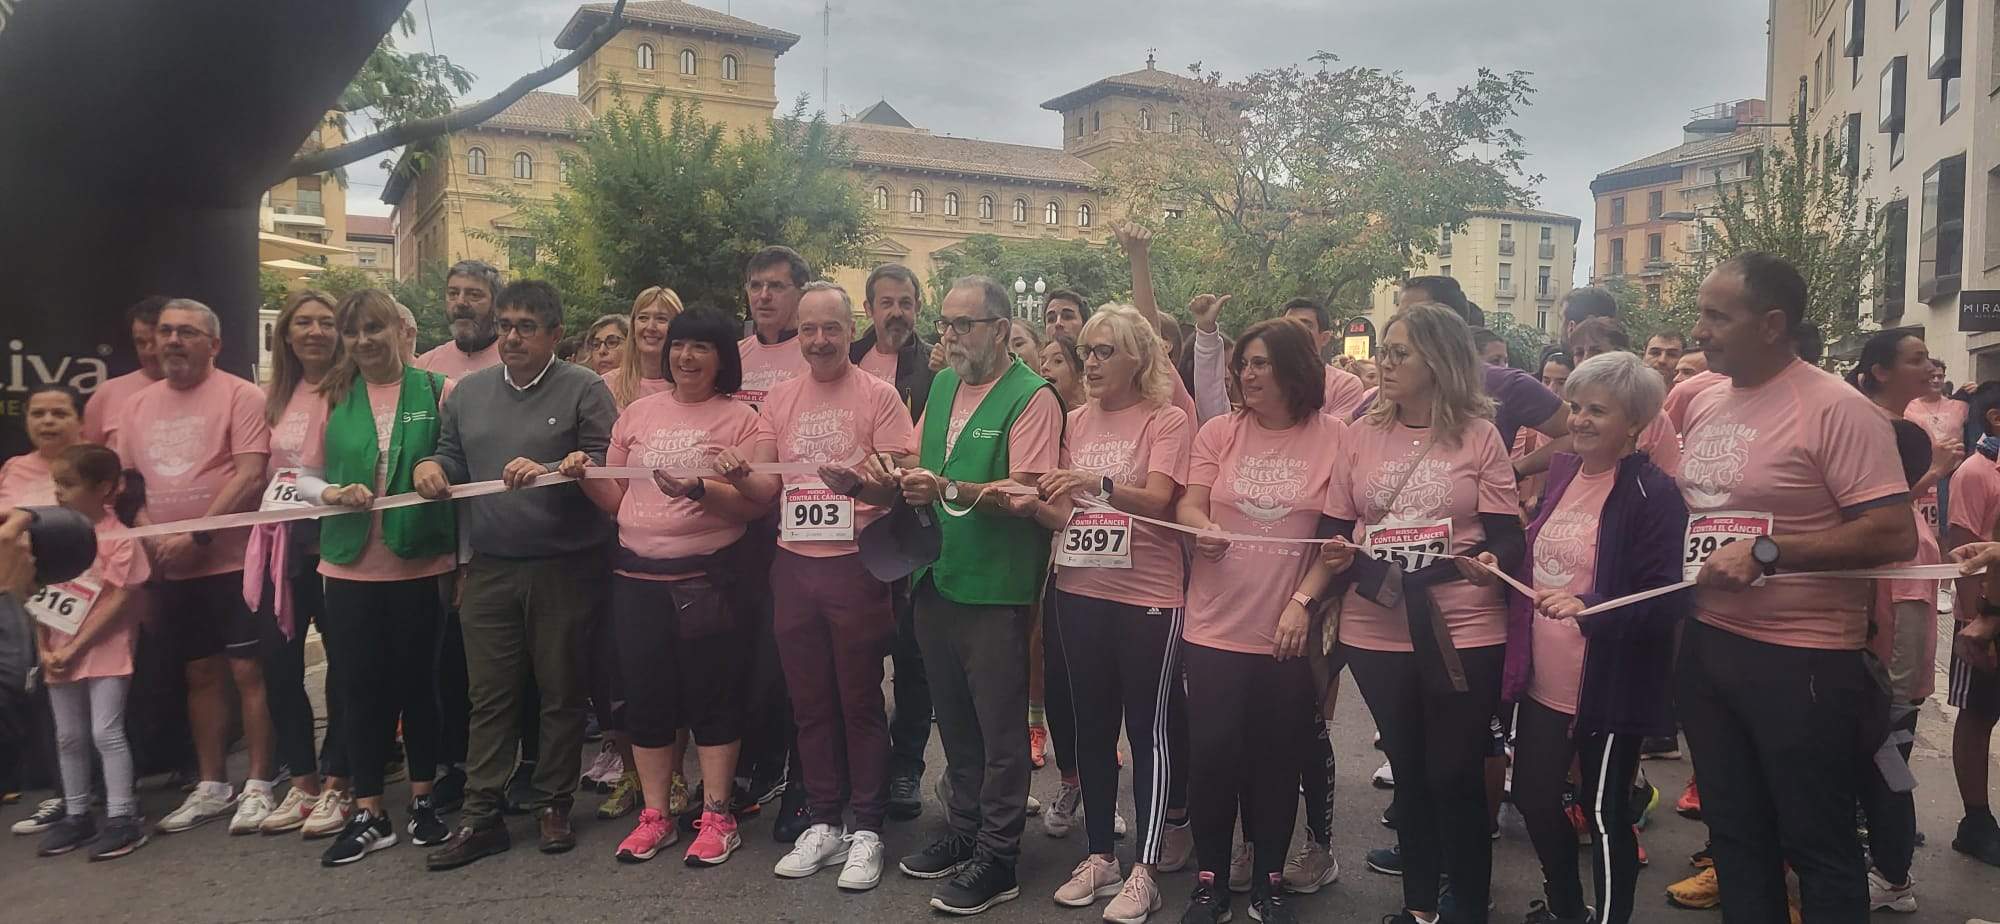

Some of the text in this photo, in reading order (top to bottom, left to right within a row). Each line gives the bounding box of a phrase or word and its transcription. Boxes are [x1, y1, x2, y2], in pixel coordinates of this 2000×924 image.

[0, 339, 108, 394] iva
[795, 504, 840, 527] 903
[1100, 518, 1125, 526] CÁNCER
[1692, 525, 1717, 534] CONTRA
[1727, 523, 1763, 534] CÁNCER
[1066, 528, 1126, 552] 3697
[1374, 535, 1402, 544] CONTRA
